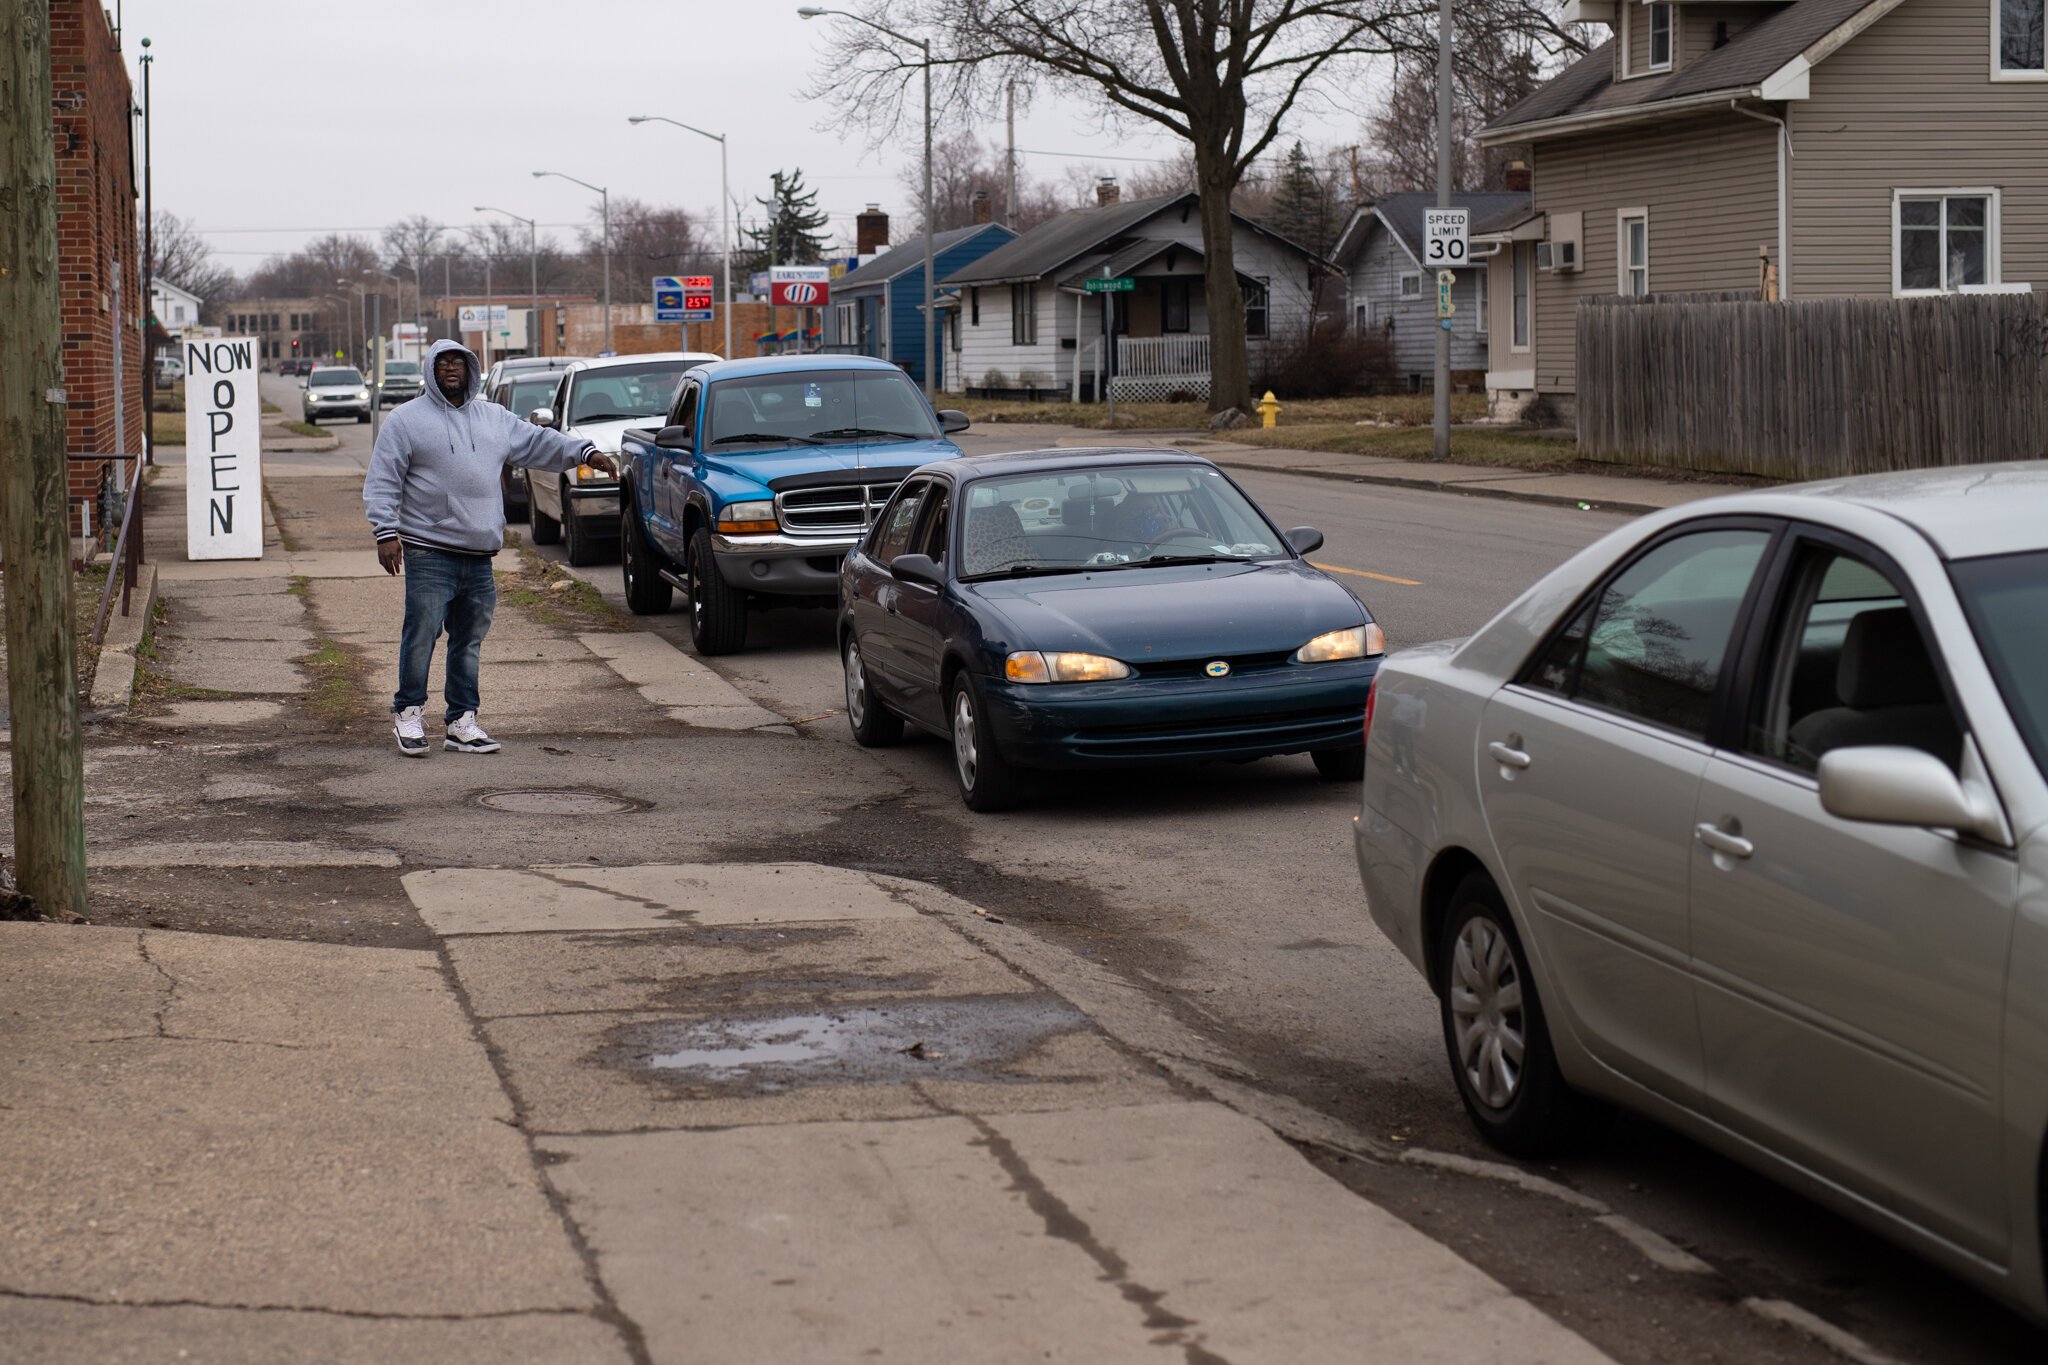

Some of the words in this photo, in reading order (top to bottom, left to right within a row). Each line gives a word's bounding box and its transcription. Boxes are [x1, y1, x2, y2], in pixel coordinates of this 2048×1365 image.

[1428, 215, 1465, 224] SPEED
[1432, 227, 1461, 236] LIMIT
[1429, 239, 1464, 259] 30
[187, 341, 252, 376] NOW
[206, 380, 240, 536] OPEN
